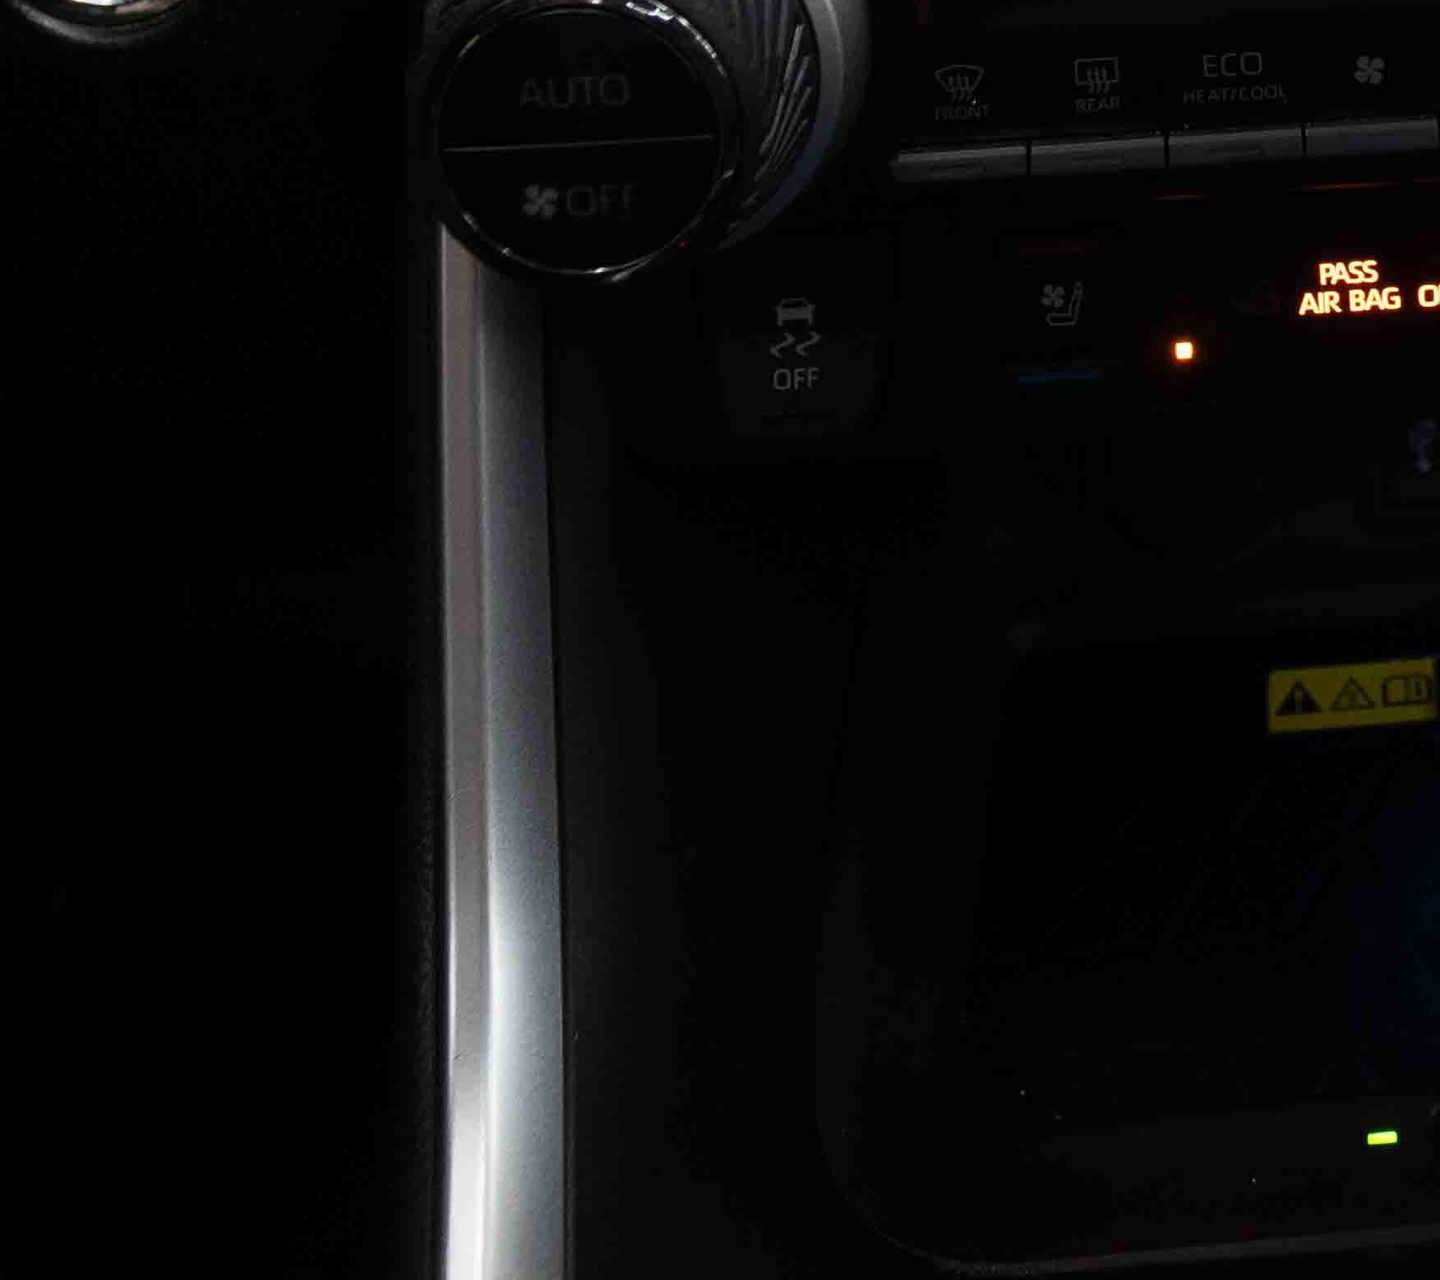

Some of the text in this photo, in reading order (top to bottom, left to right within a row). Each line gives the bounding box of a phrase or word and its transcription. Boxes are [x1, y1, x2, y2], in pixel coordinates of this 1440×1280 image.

[1201, 51, 1264, 78] ECO
[518, 70, 633, 111] AUTO
[563, 184, 640, 219] OFF
[1318, 259, 1379, 286] PASS
[1298, 291, 1342, 316] AIR
[1348, 286, 1402, 312] BAG
[771, 366, 821, 392] OFF
